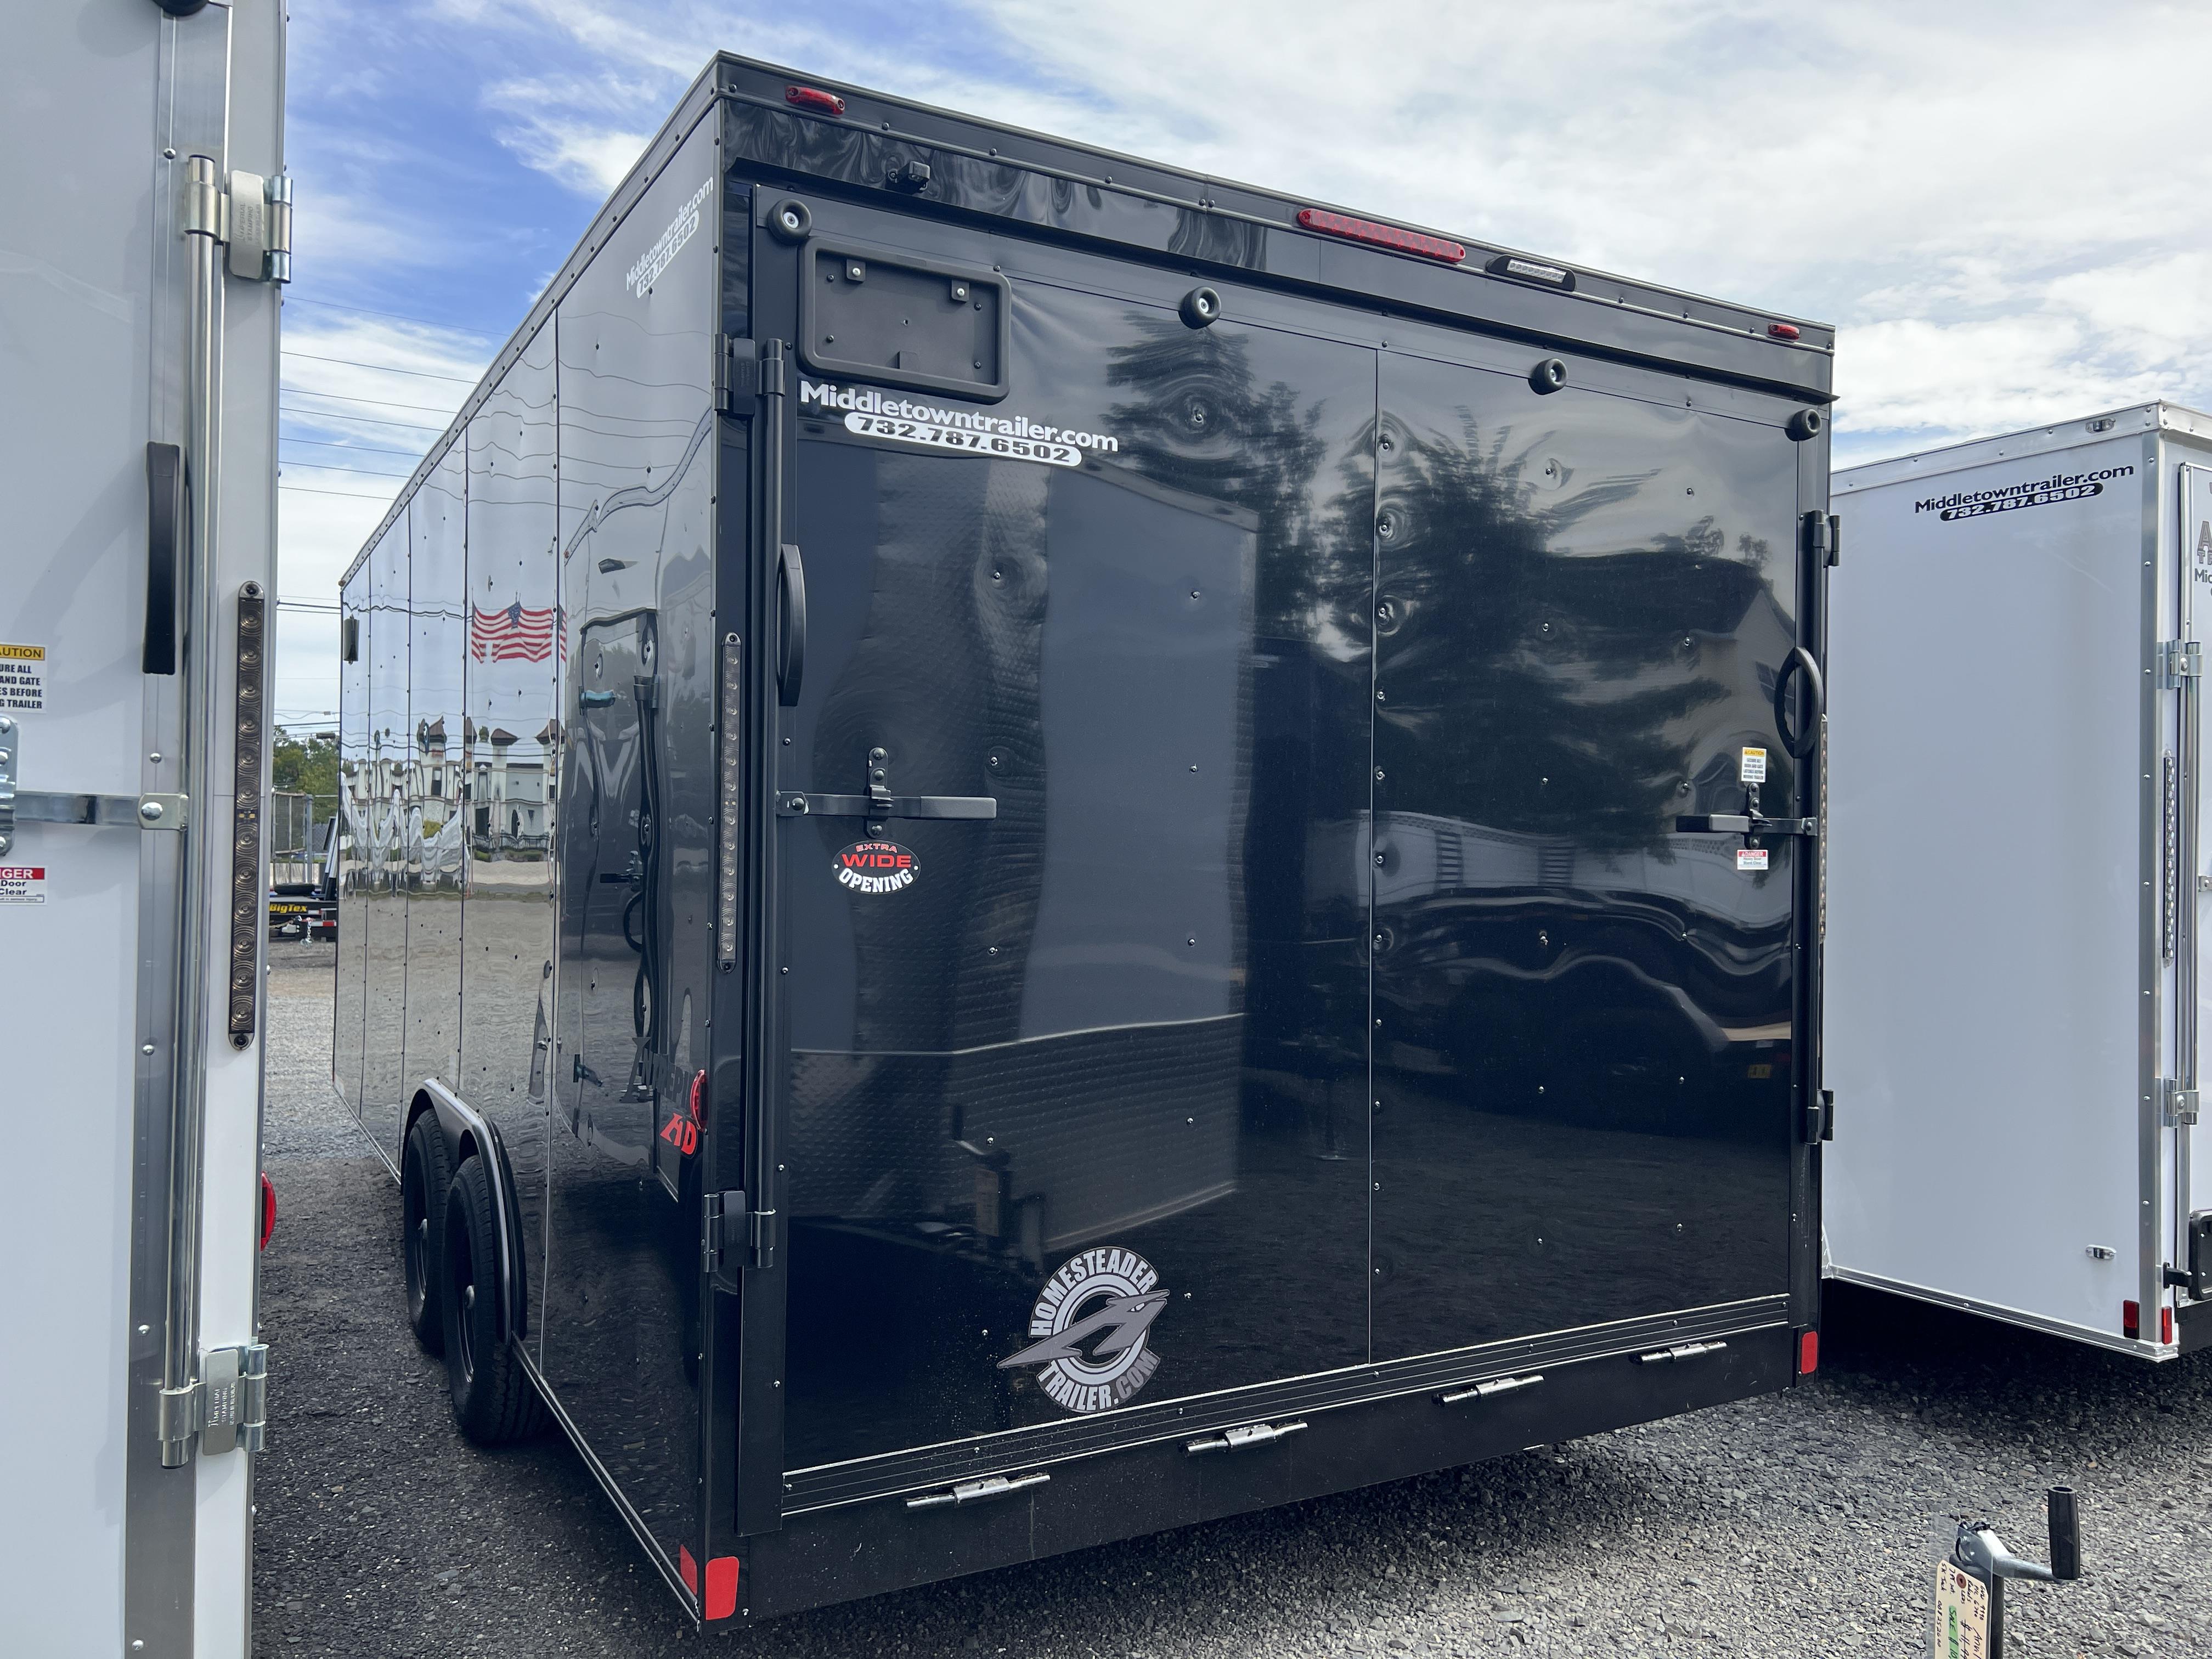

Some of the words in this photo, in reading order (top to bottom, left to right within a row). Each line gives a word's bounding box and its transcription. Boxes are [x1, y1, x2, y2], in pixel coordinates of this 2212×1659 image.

[626, 176, 713, 291] Middletowntrailer.com
[639, 216, 696, 292] 732.787.6502
[800, 380, 1119, 452] Middletowntrailer.com
[857, 416, 1070, 463] 732.787.6502
[1915, 465, 2134, 514] Middletowntrailer.com
[1946, 484, 2096, 520] 732.787.6502
[0, 647, 41, 658] UTION
[18, 665, 32, 674] ALL
[19, 676, 41, 686] GATE
[10, 688, 42, 697] BEFORE
[7, 699, 42, 709] TRAILER
[855, 843, 898, 853] EXTRA
[842, 854, 912, 868] WIDE
[0, 868, 33, 879] GER
[838, 868, 914, 893] OPENING
[1030, 1249, 1158, 1336] HOMESTEADER
